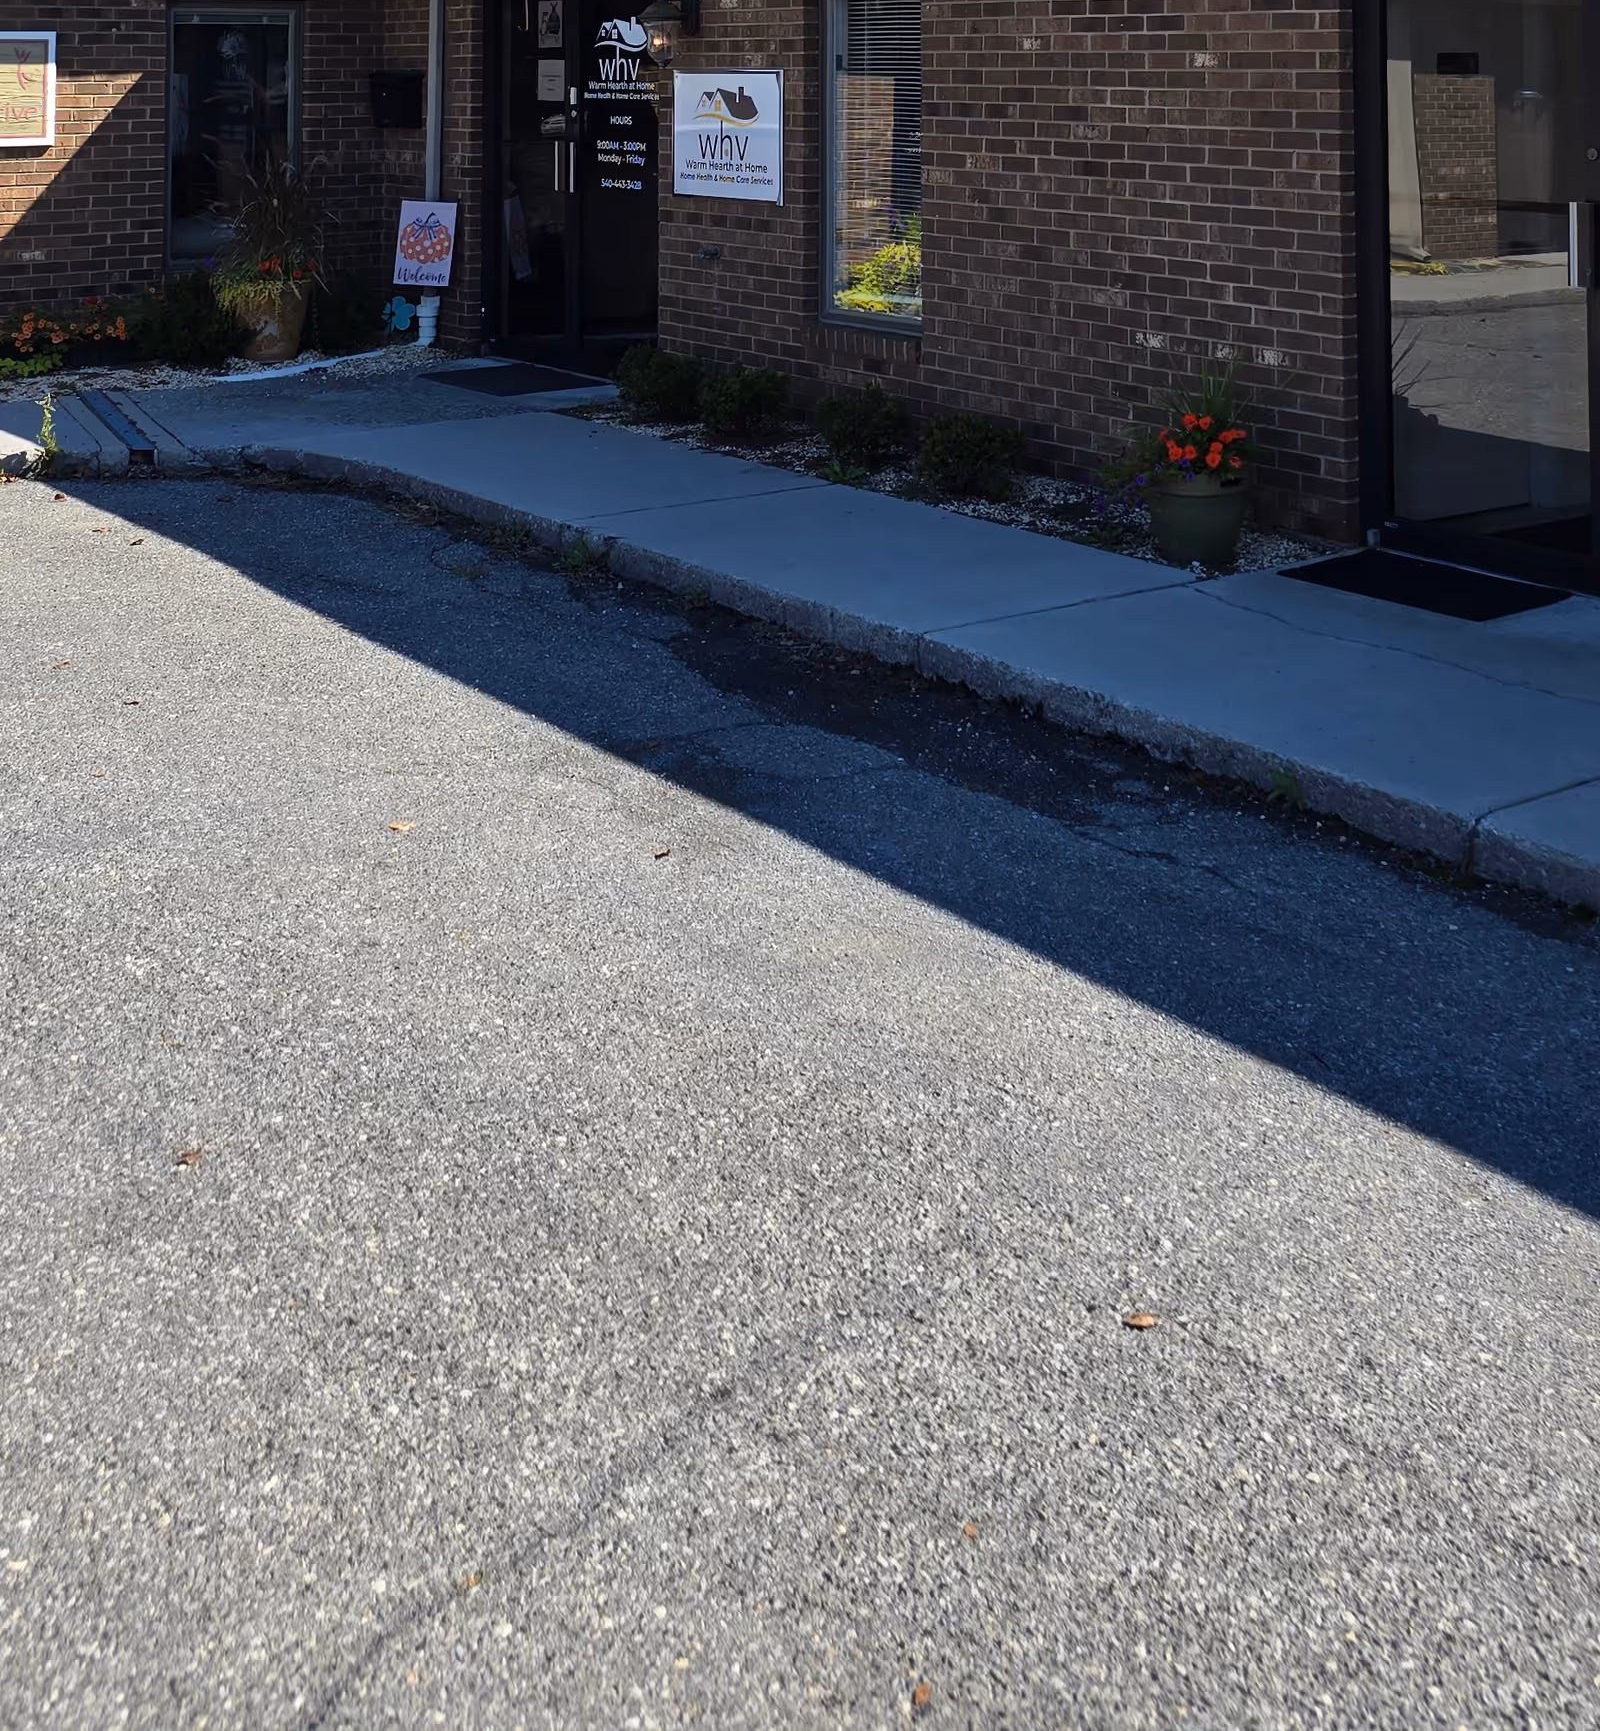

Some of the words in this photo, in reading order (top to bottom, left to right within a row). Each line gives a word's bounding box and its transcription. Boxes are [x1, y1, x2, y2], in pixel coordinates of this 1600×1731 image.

[599, 47, 640, 81] whv
[588, 81, 607, 90] Warm
[608, 81, 628, 91] Hearth
[629, 82, 635, 91] at
[636, 82, 655, 91] Home
[610, 116, 633, 125] HOURS
[699, 120, 748, 161] whv
[598, 153, 621, 165] Monday
[626, 154, 645, 166] Friday
[685, 159, 707, 169] Warm
[709, 160, 733, 172] Hearth
[735, 163, 743, 172] at
[745, 163, 768, 173] Home
[680, 172, 695, 181] Home
[696, 172, 713, 181] Health
[719, 174, 735, 183] Home
[736, 175, 749, 184] Care
[750, 176, 774, 186] Services
[397, 265, 446, 284] Welcome
